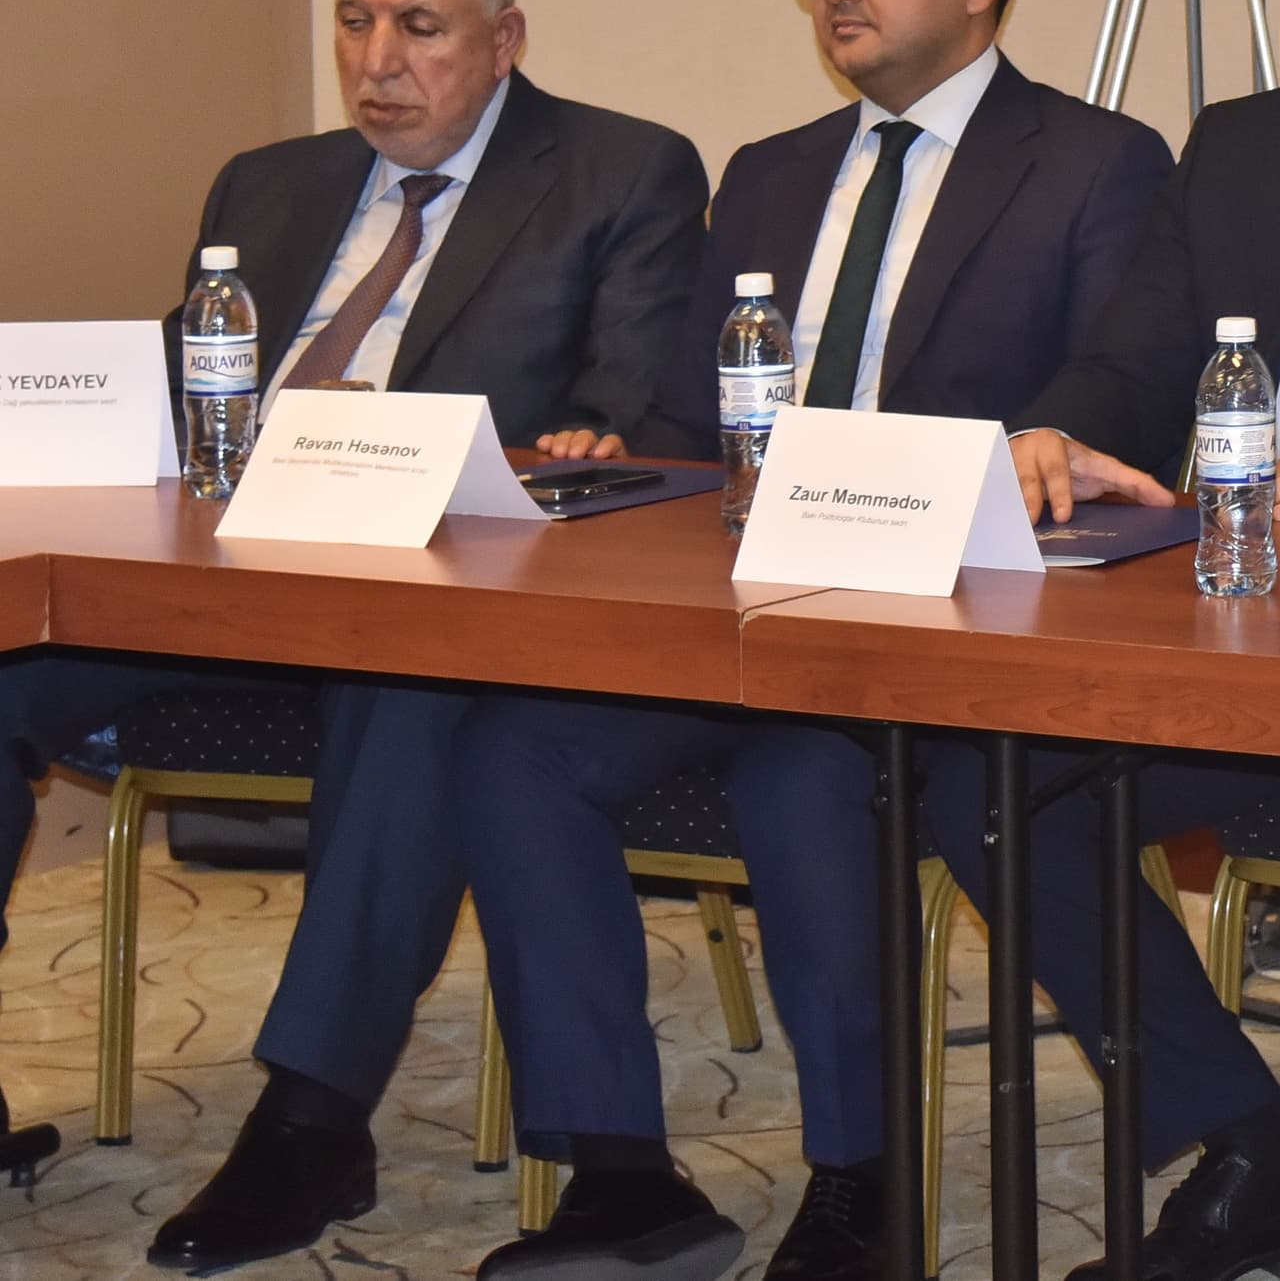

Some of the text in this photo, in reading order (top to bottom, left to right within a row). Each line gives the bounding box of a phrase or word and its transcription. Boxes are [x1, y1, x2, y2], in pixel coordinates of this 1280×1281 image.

[190, 353, 254, 371] AQUAVITA
[8, 374, 108, 390] YEVDAYEV
[293, 436, 422, 458] Rəvan Həsənov
[789, 485, 932, 511] Zaur Məmmədov
